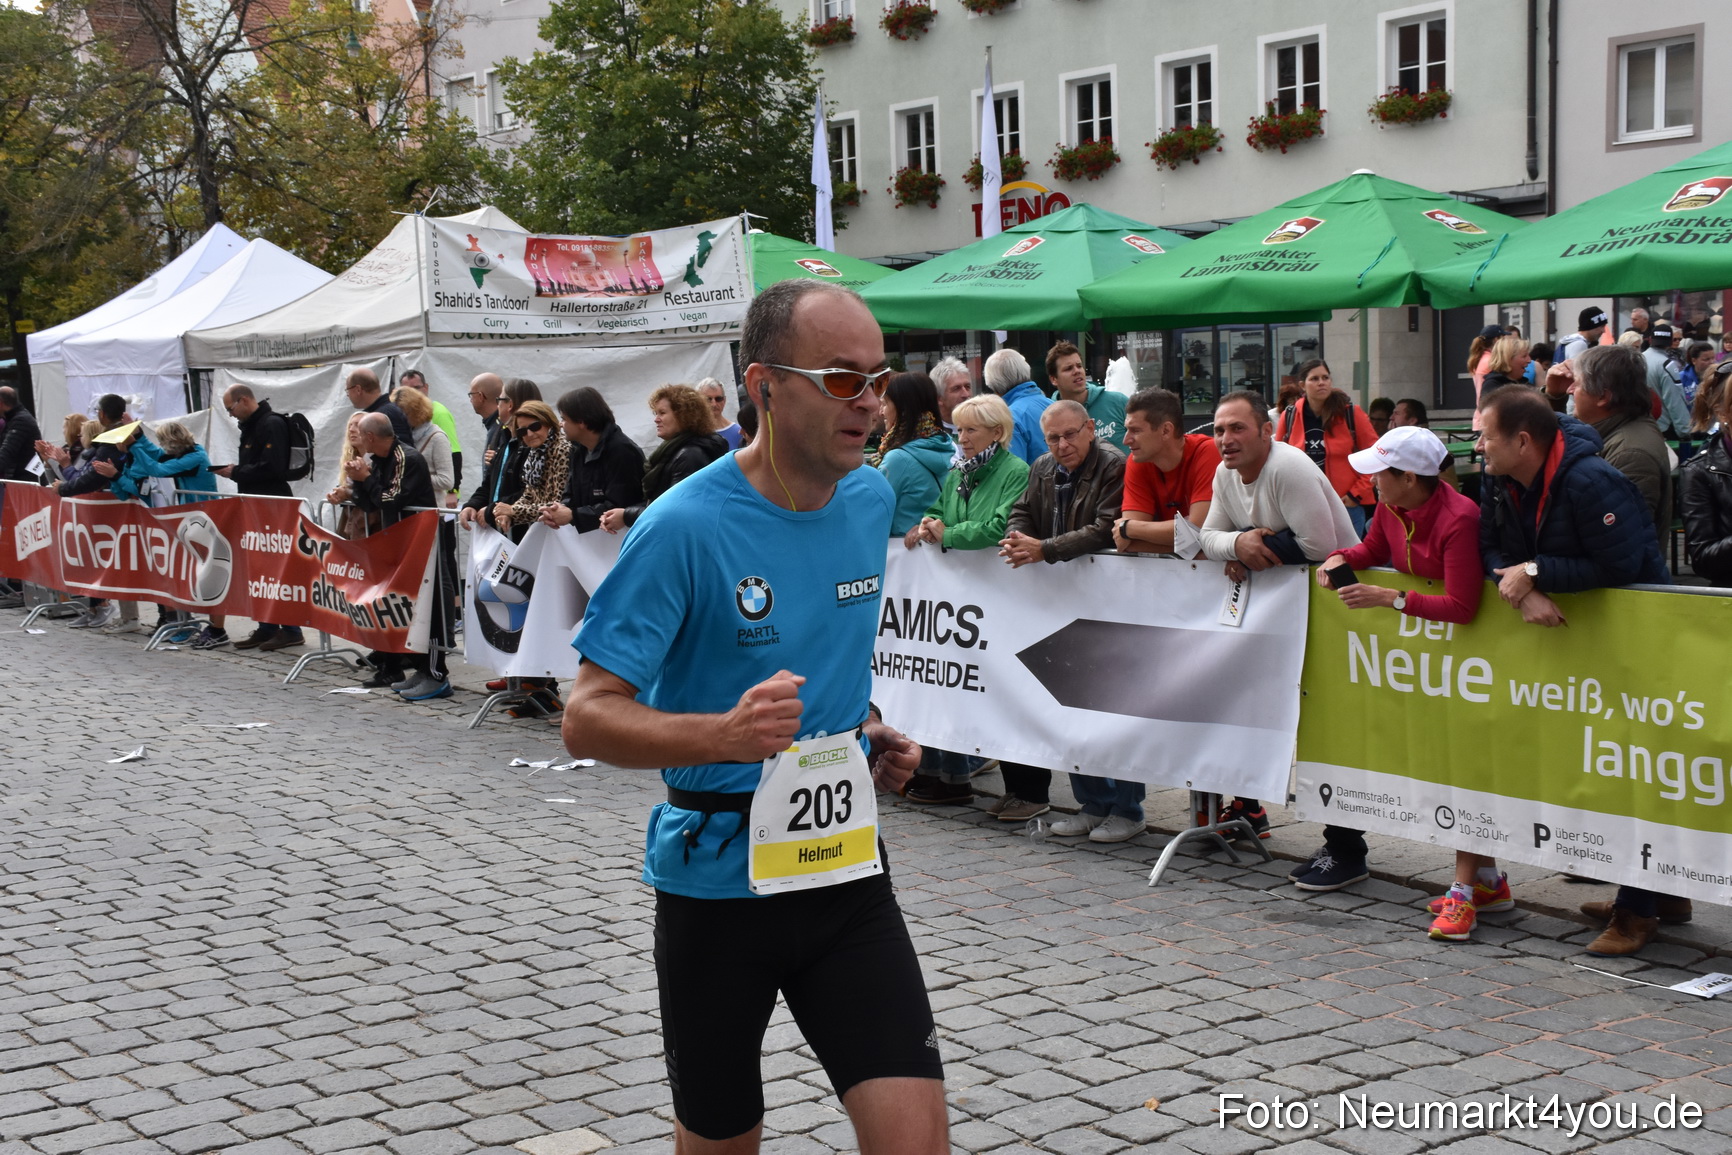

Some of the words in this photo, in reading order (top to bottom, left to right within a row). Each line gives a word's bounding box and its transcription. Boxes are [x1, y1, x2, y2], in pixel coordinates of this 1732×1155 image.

[1600, 216, 1732, 239] Neumarkte
[557, 243, 570, 253] Tel.
[1559, 228, 1732, 258] Lammsbrä
[638, 241, 659, 290] PAKISTAN
[731, 230, 744, 298] AKISTANISCH
[434, 291, 482, 308] Shahid's
[484, 293, 530, 311] Tandoori
[550, 301, 635, 313] Hallertorstraße
[637, 299, 648, 309] 21
[664, 286, 736, 306] Restaurant
[483, 317, 509, 329] Curry
[543, 319, 562, 329] Grill
[597, 316, 649, 329] Vegetarisch
[680, 311, 708, 323] Vegan
[327, 561, 348, 577] und
[348, 563, 364, 581] die
[737, 578, 769, 594] BMW
[836, 574, 880, 600] BOCK
[372, 592, 416, 629] Hit
[737, 625, 779, 640] PARTL
[878, 597, 988, 650] AMICS.
[737, 636, 780, 647] Neumarkt
[871, 651, 986, 693] AHRFREUDE.
[1347, 630, 1494, 703] Neue
[1509, 676, 1614, 721] weiß,
[810, 747, 848, 766] BOCK
[1583, 726, 1732, 806] langg
[787, 779, 853, 832] 203
[1336, 786, 1395, 805] Dammstraße
[1396, 796, 1402, 807] 1
[1337, 800, 1381, 818] Neumarkt
[1382, 809, 1388, 819] i.
[1389, 811, 1398, 821] d.
[1400, 812, 1420, 824] OPf.
[758, 829, 766, 839] C
[1491, 829, 1509, 843] Uhr
[1555, 827, 1580, 842] über
[1582, 832, 1604, 847] 500
[798, 842, 843, 863] Helmut
[1556, 843, 1613, 864] Parkplätze
